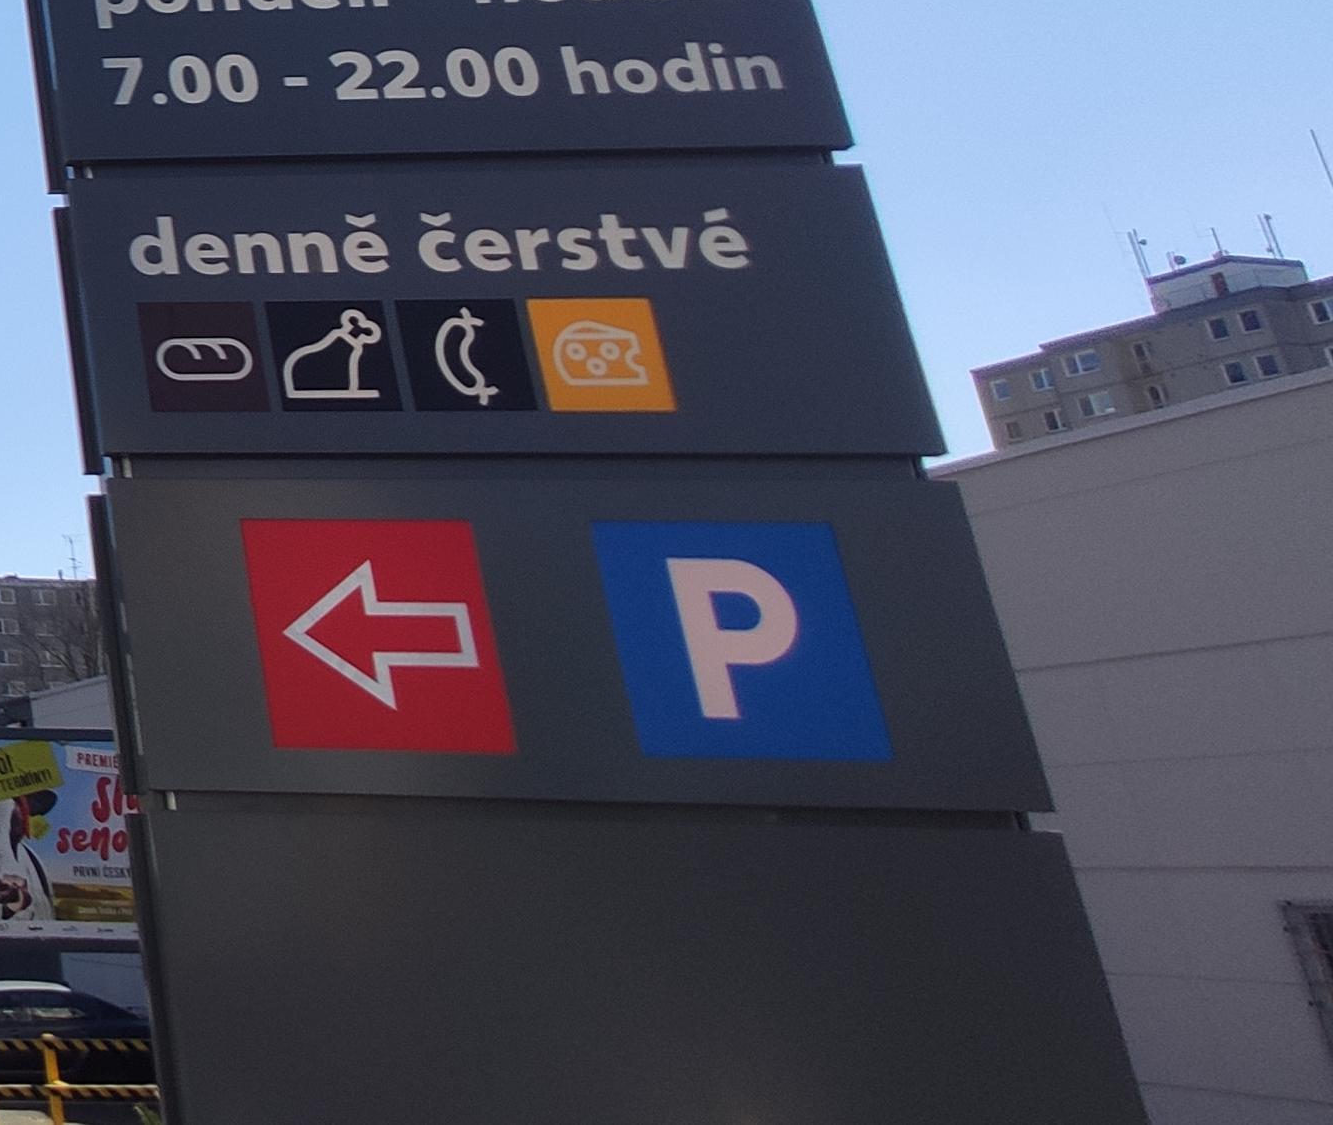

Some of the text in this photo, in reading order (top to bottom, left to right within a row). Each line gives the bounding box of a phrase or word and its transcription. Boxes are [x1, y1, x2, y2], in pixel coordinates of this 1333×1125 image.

[102, 42, 784, 105] 7.00 - 22.00 hodin
[129, 207, 750, 276] denně čerstvé
[666, 557, 798, 719] P
